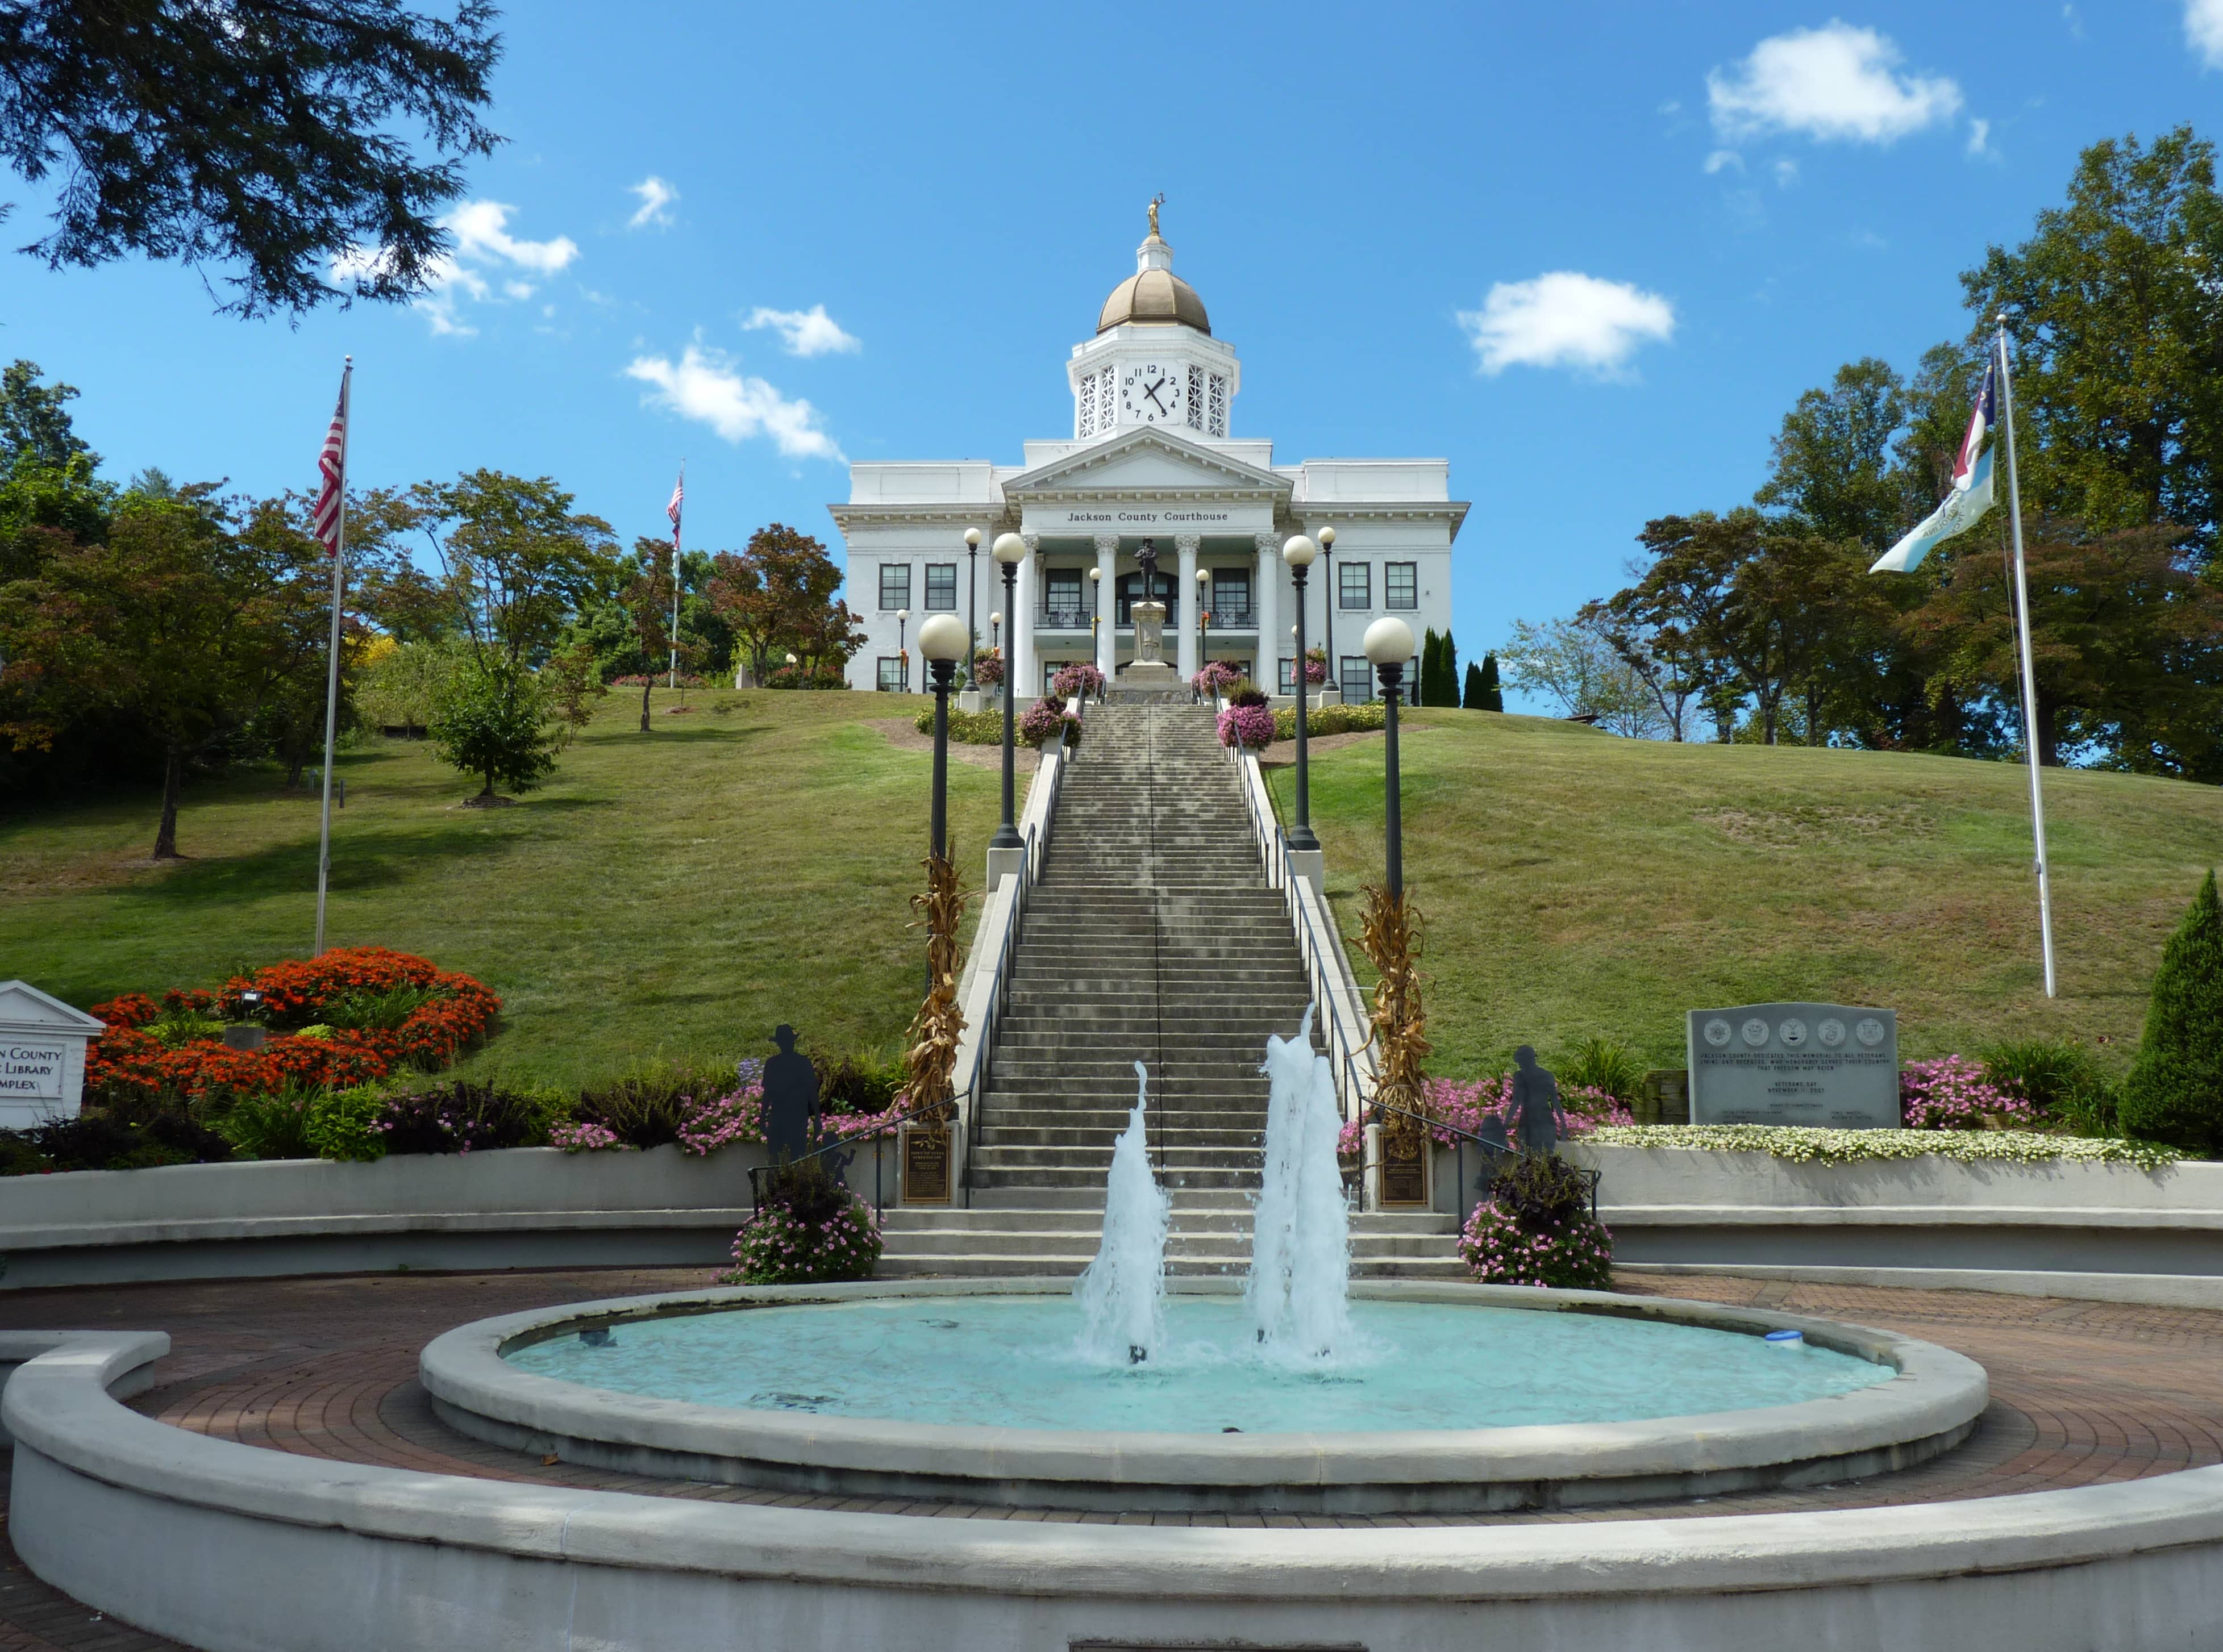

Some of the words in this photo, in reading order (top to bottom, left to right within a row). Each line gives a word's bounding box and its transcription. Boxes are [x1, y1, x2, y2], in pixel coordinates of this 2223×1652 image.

[1135, 368, 1141, 377] 11
[1148, 365, 1156, 373] 12
[1162, 368, 1165, 377] 1
[1125, 377, 1134, 386] 10
[1170, 377, 1176, 385] 2
[1175, 389, 1180, 397] 3
[1170, 401, 1176, 409] 4
[1118, 512, 1158, 522] County
[1164, 512, 1228, 521] Courthouse
